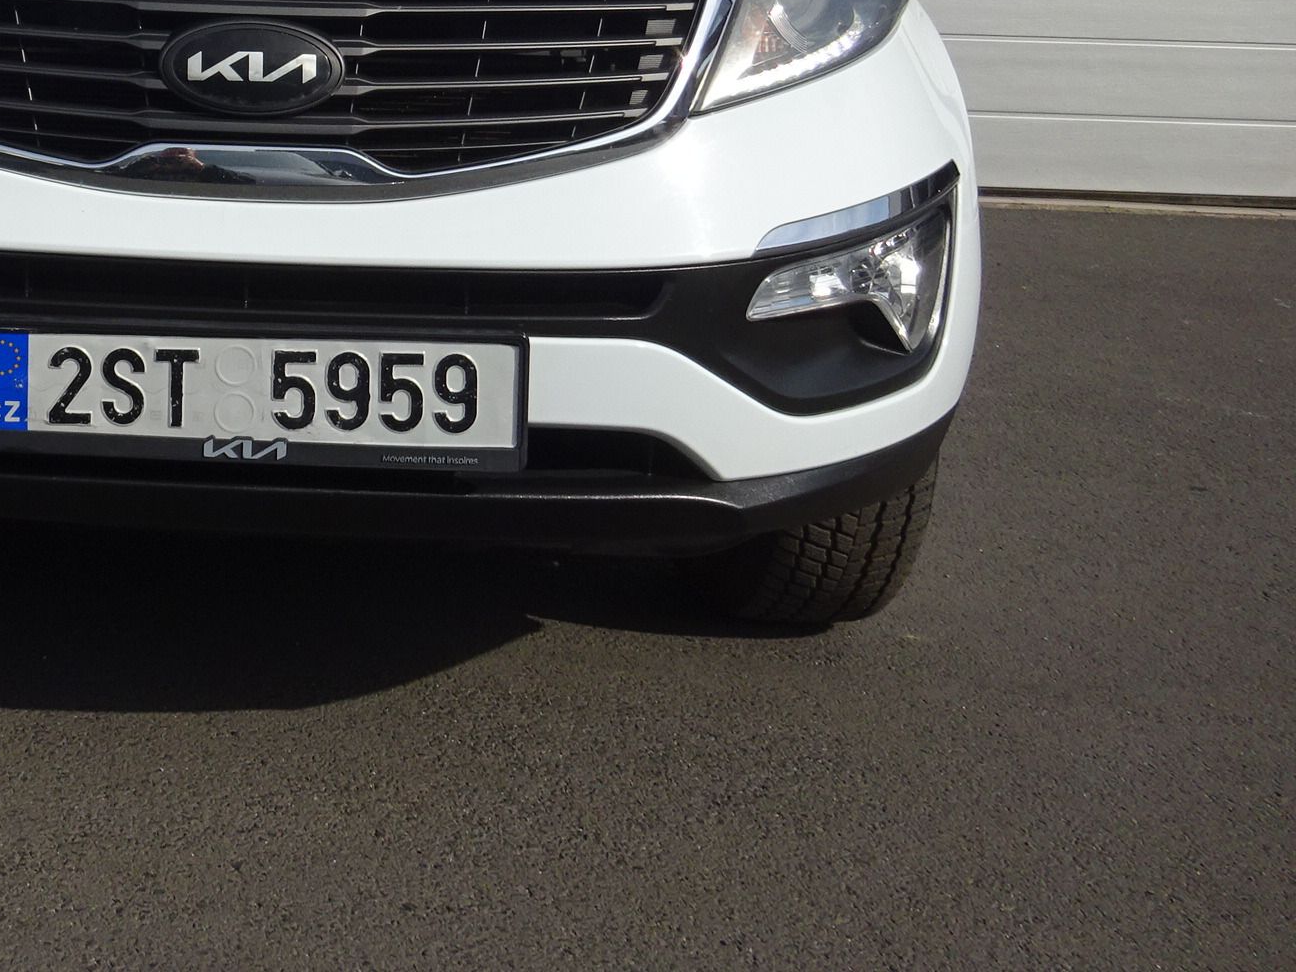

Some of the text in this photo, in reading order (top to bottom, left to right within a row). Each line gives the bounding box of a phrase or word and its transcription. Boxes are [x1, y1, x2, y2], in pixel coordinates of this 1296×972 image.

[187, 50, 317, 84] KIA
[46, 346, 478, 434] 2ST 5959
[203, 437, 288, 460] KIA
[382, 454, 426, 464] Movement
[428, 455, 445, 464] that
